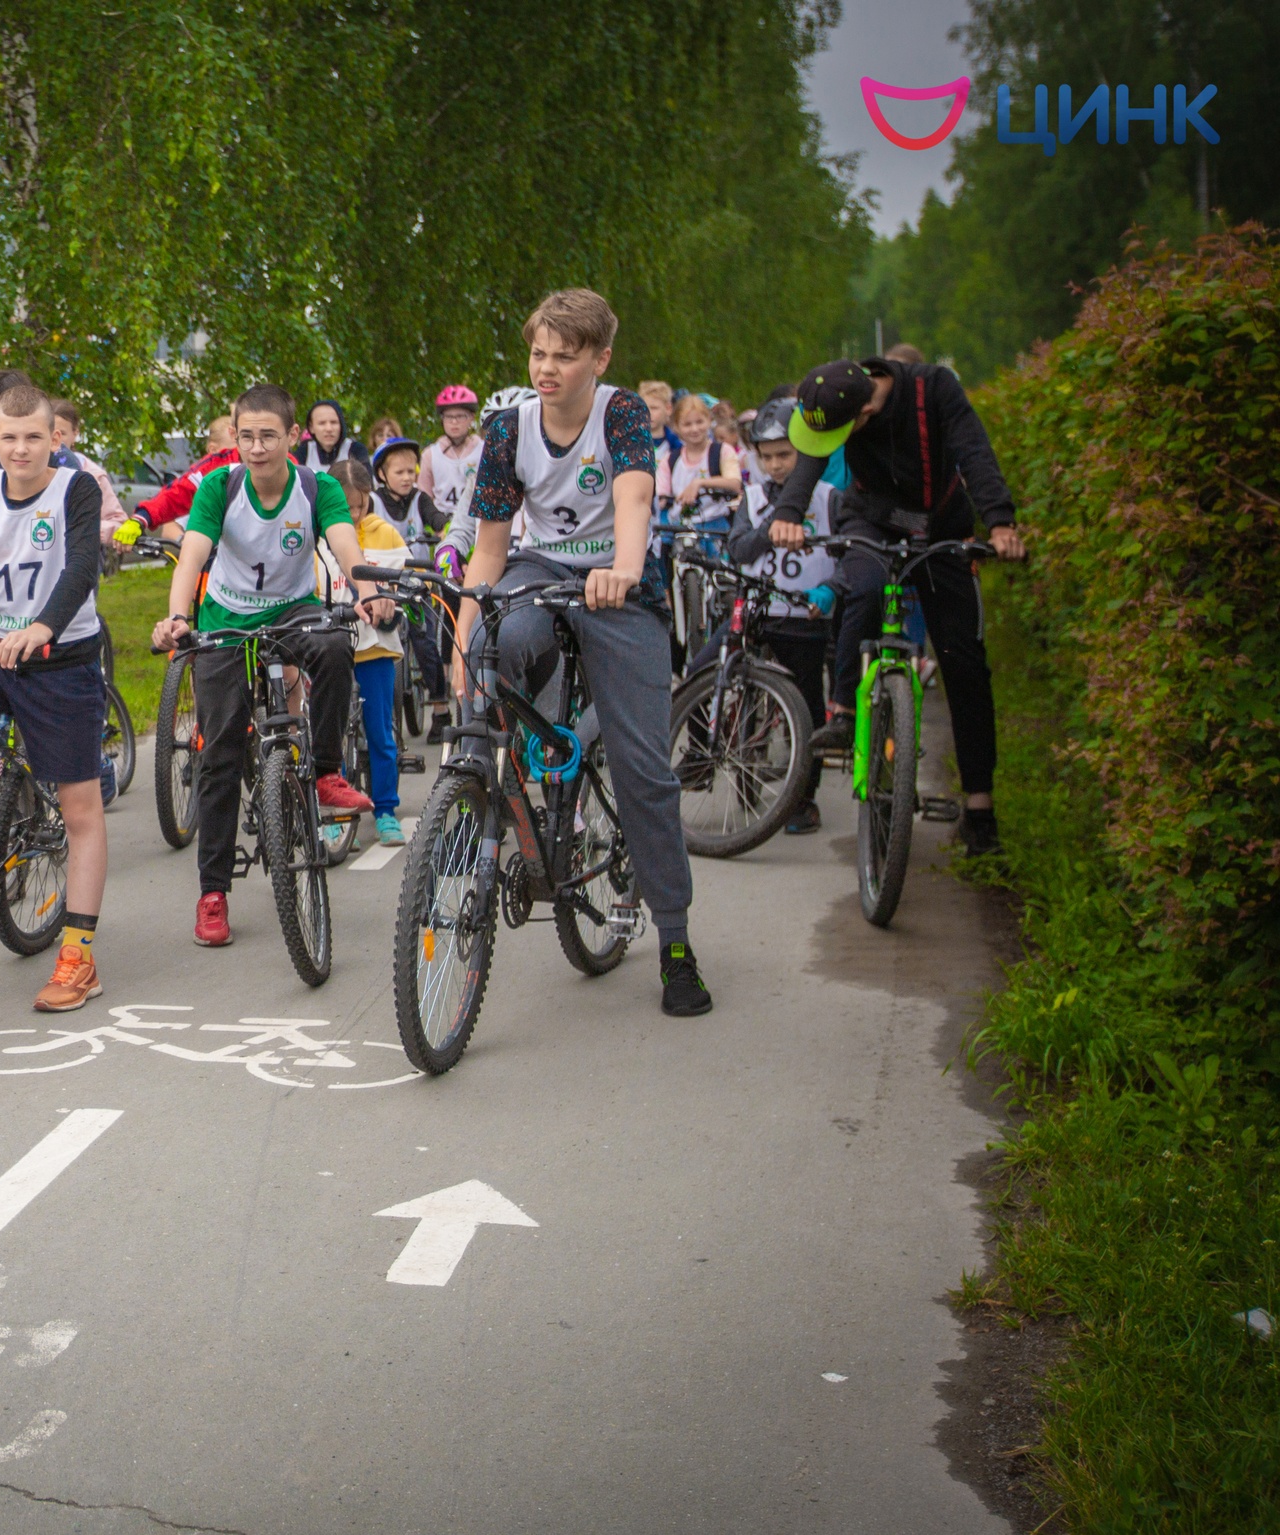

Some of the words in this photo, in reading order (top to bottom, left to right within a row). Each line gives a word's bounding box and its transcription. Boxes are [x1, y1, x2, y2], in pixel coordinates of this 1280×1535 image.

[552, 506, 581, 535] 3
[251, 562, 266, 591] 1
[761, 549, 802, 578] 36
